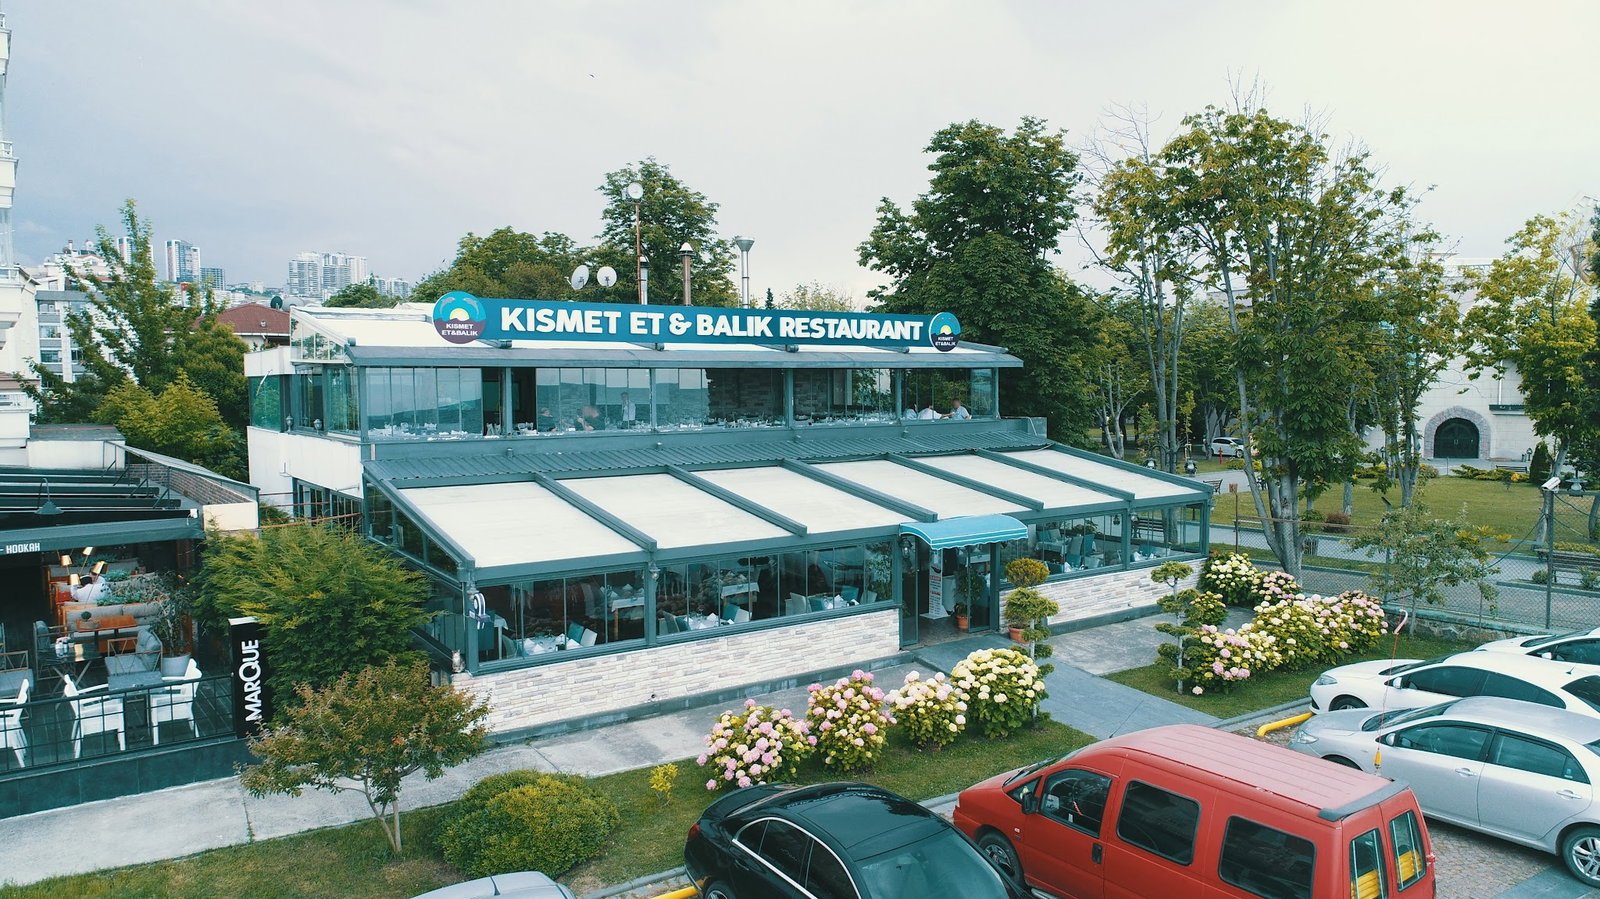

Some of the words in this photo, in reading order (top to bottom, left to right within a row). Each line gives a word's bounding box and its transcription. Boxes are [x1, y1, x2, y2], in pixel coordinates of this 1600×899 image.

[502, 307, 621, 333] KISMET
[630, 312, 664, 335] ET
[669, 313, 692, 335] &
[697, 314, 773, 337] BALIK
[780, 317, 923, 340] RESTAURANT
[6, 543, 40, 554] HOOKAH
[239, 640, 262, 721] MARQUE
